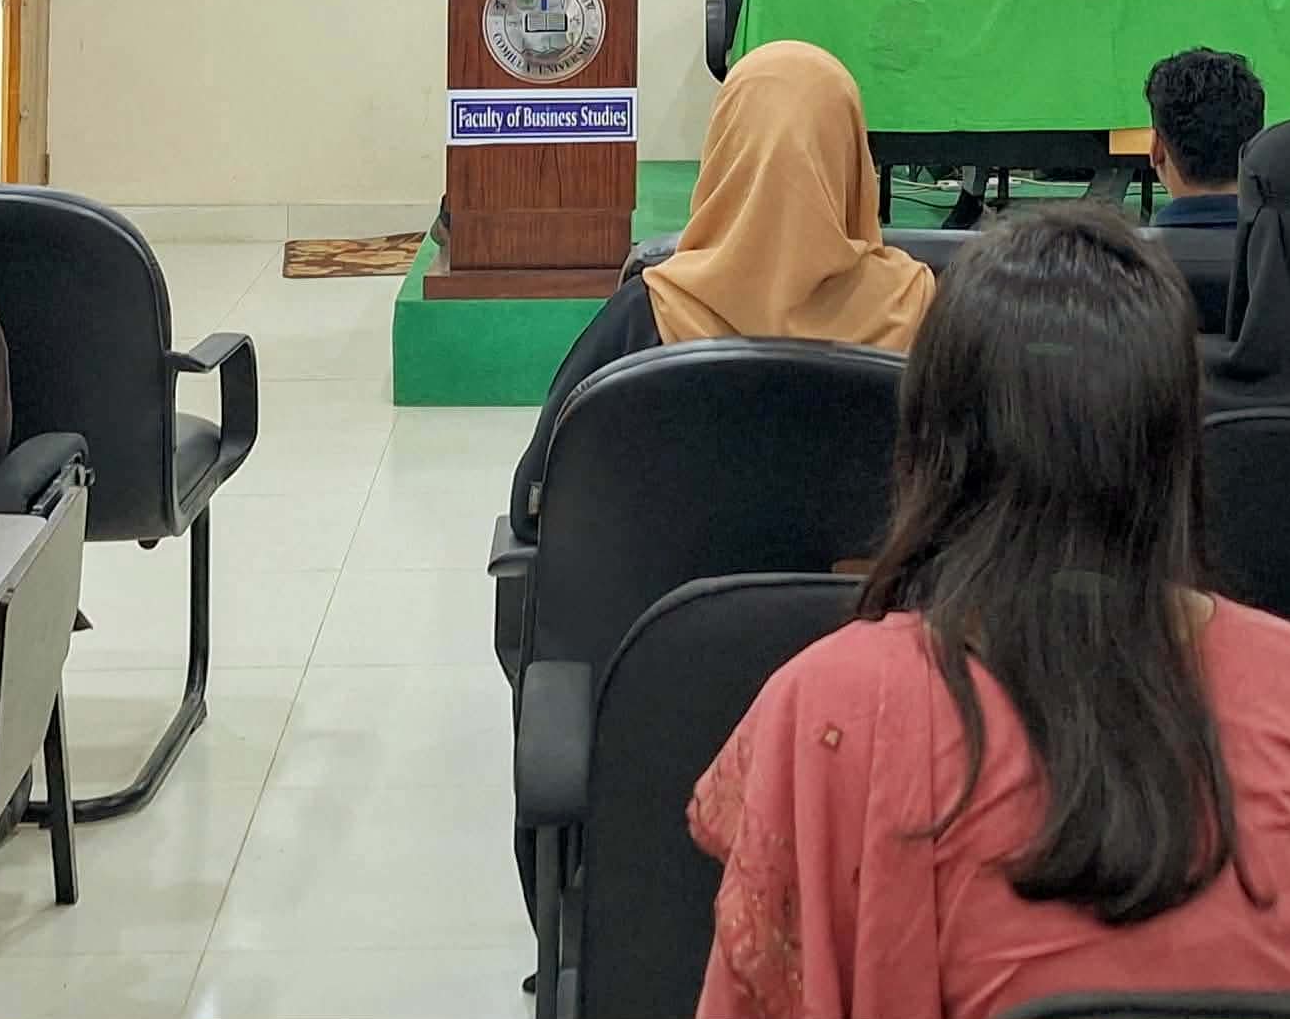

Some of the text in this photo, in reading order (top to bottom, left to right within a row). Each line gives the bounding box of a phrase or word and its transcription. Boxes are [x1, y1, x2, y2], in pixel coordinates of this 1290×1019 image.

[538, 32, 595, 75] UNIVERSITY
[459, 104, 627, 132] Faculty of Business Studies
